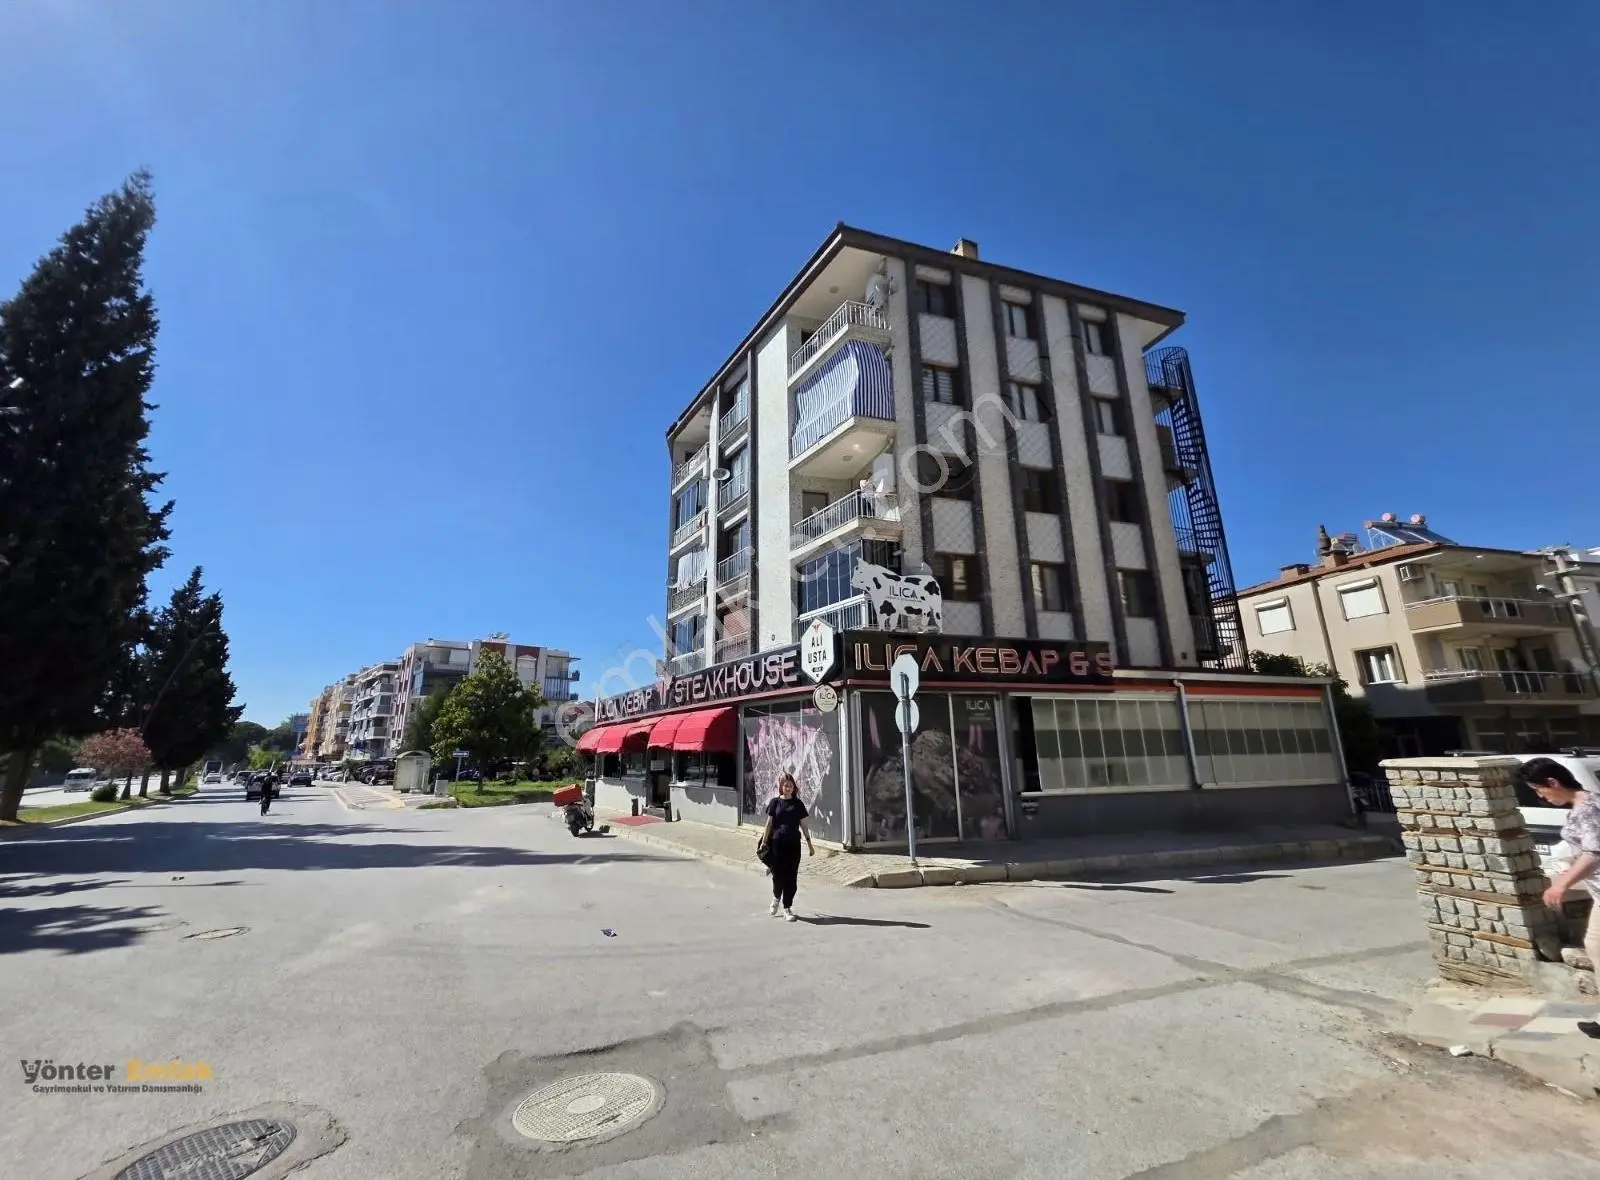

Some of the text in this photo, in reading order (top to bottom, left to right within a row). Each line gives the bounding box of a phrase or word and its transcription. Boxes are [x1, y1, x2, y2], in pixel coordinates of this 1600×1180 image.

[811, 635, 823, 648] ALI
[807, 650, 828, 664] USTA
[952, 646, 1059, 675] KEBAP
[674, 650, 797, 703] STEAKHOUSE
